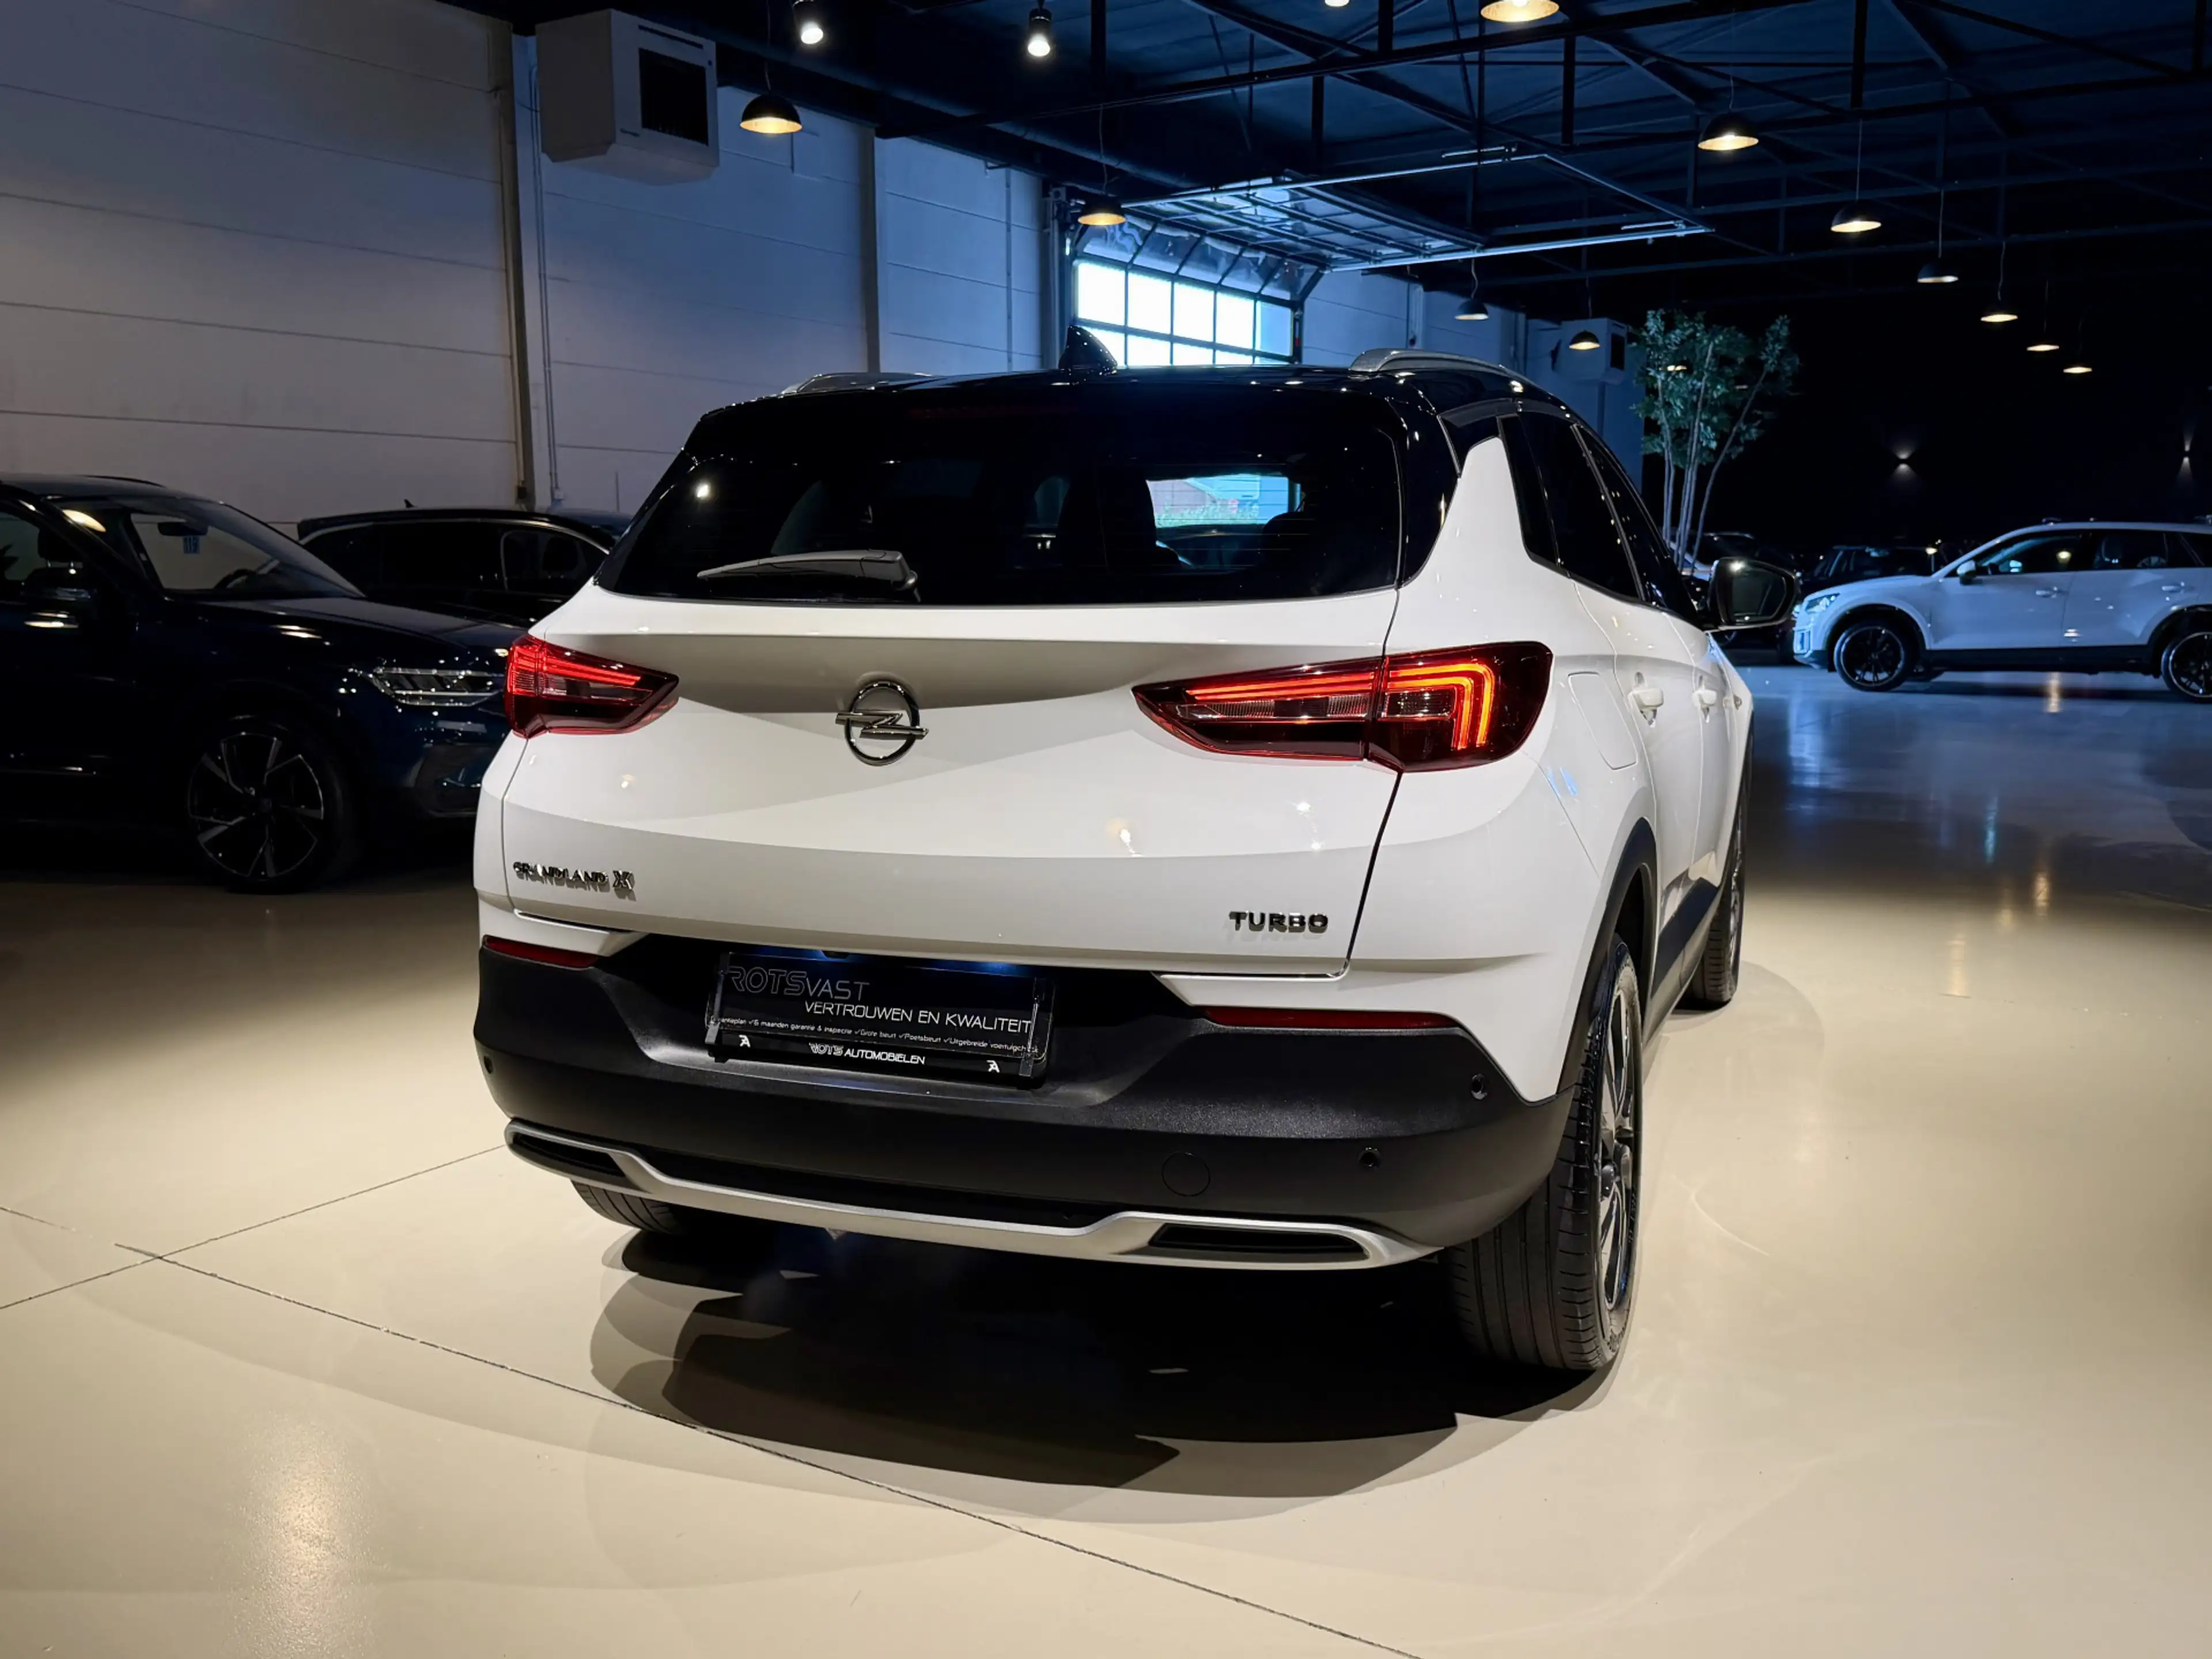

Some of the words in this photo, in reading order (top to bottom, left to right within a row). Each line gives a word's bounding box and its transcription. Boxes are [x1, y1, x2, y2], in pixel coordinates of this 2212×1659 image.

[513, 862, 609, 883] GRANDLAND
[612, 870, 635, 889] X
[1229, 911, 1328, 933] TURBO
[728, 965, 870, 1001] ROTSVAST
[760, 1021, 789, 1030] maanden
[790, 1023, 815, 1031] garantie
[824, 1026, 853, 1035] inspectie
[805, 1001, 913, 1022] VERTROUWEN
[918, 1010, 941, 1024] EN
[945, 1012, 1032, 1033] KWALITEIT
[844, 1048, 926, 1065] AUTOMOBIELEN
